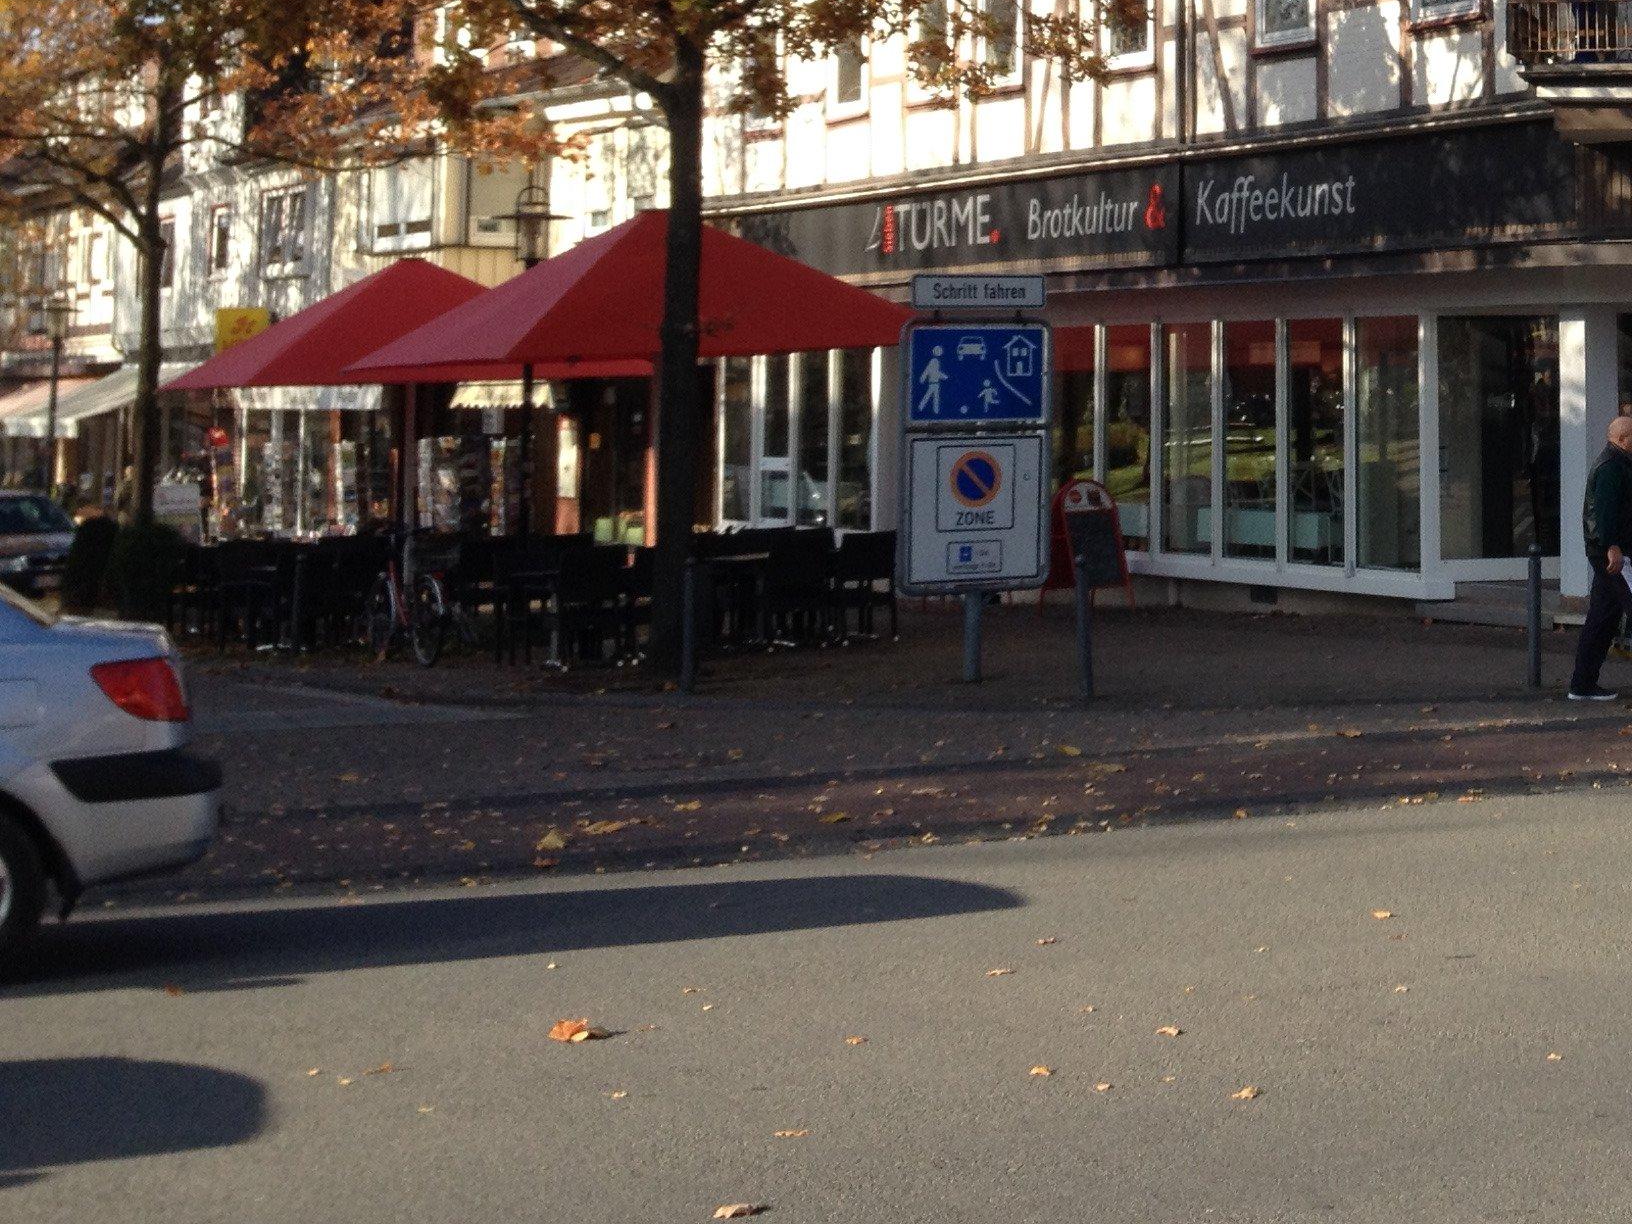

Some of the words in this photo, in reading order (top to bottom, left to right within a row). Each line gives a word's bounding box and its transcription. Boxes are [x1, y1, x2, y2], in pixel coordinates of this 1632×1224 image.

[1027, 190, 1139, 240] Brotkultur
[1143, 183, 1165, 231] &
[1195, 172, 1356, 234] Kaffeekunst
[933, 282, 978, 299] Schritt
[984, 282, 1026, 299] fahren
[956, 510, 995, 526] ZONE
